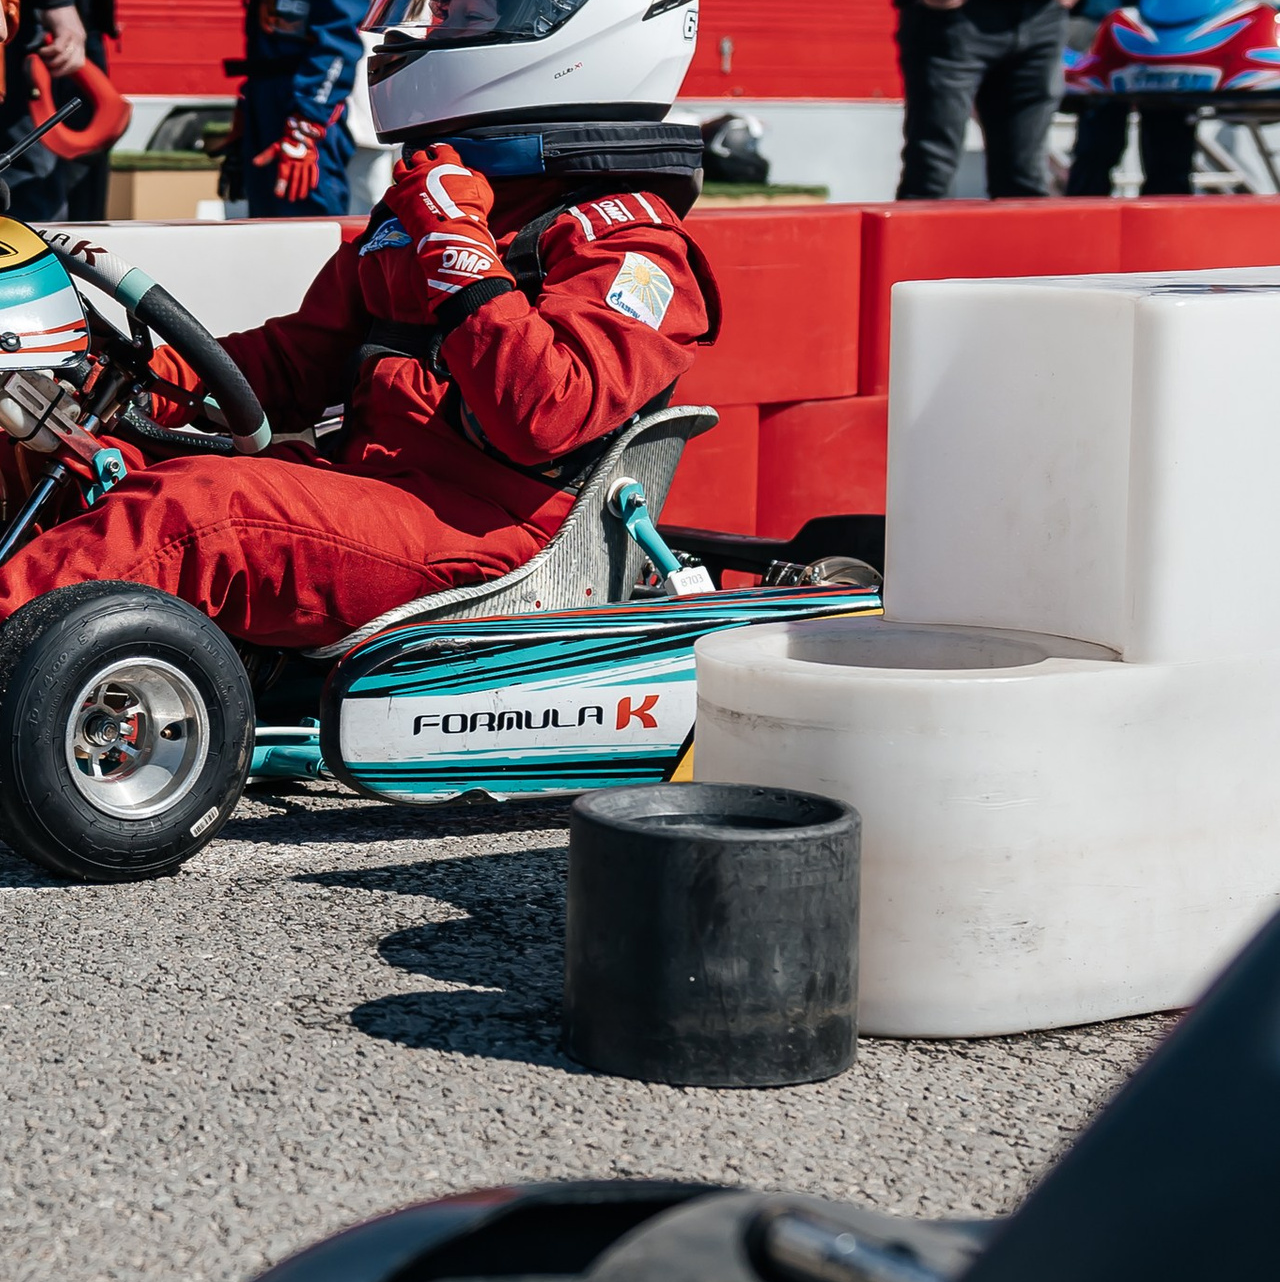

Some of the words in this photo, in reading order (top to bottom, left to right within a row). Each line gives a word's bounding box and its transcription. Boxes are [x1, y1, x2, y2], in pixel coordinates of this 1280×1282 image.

[419, 192, 441, 215] FIRST
[599, 200, 628, 223] OMP
[442, 250, 492, 274] OMP
[680, 573, 704, 587] 8703
[413, 706, 604, 735] FORMULA
[616, 695, 659, 730] K
